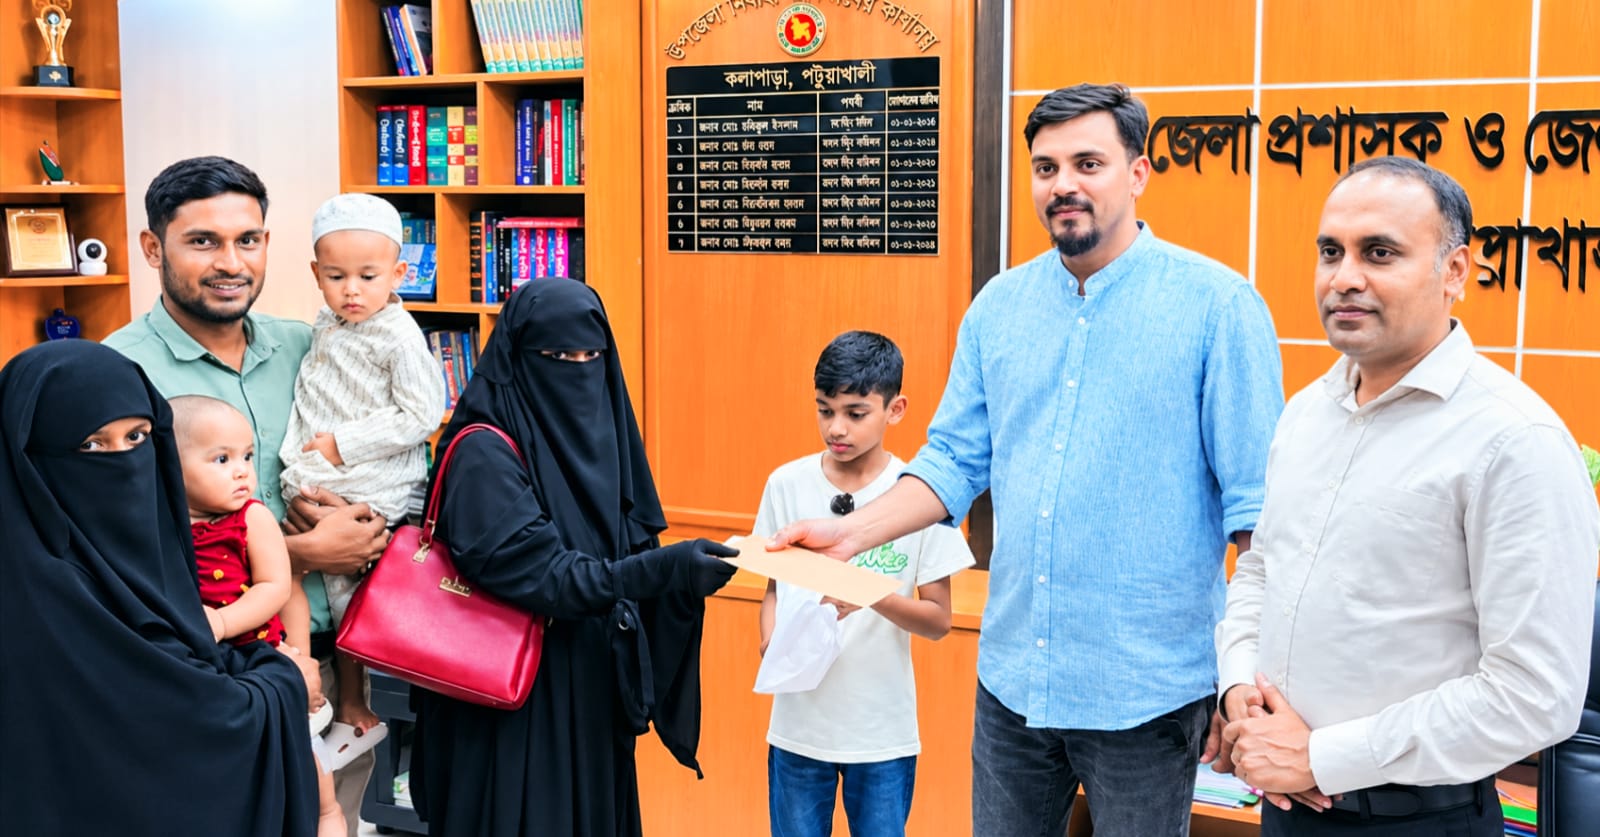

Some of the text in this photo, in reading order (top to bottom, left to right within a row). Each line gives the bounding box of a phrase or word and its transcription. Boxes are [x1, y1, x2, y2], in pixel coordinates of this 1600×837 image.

[724, 60, 876, 90] কলাপাড়া, পটুয়াখালী
[1148, 106, 1600, 177] জেলা প্রশাসক ও জে
